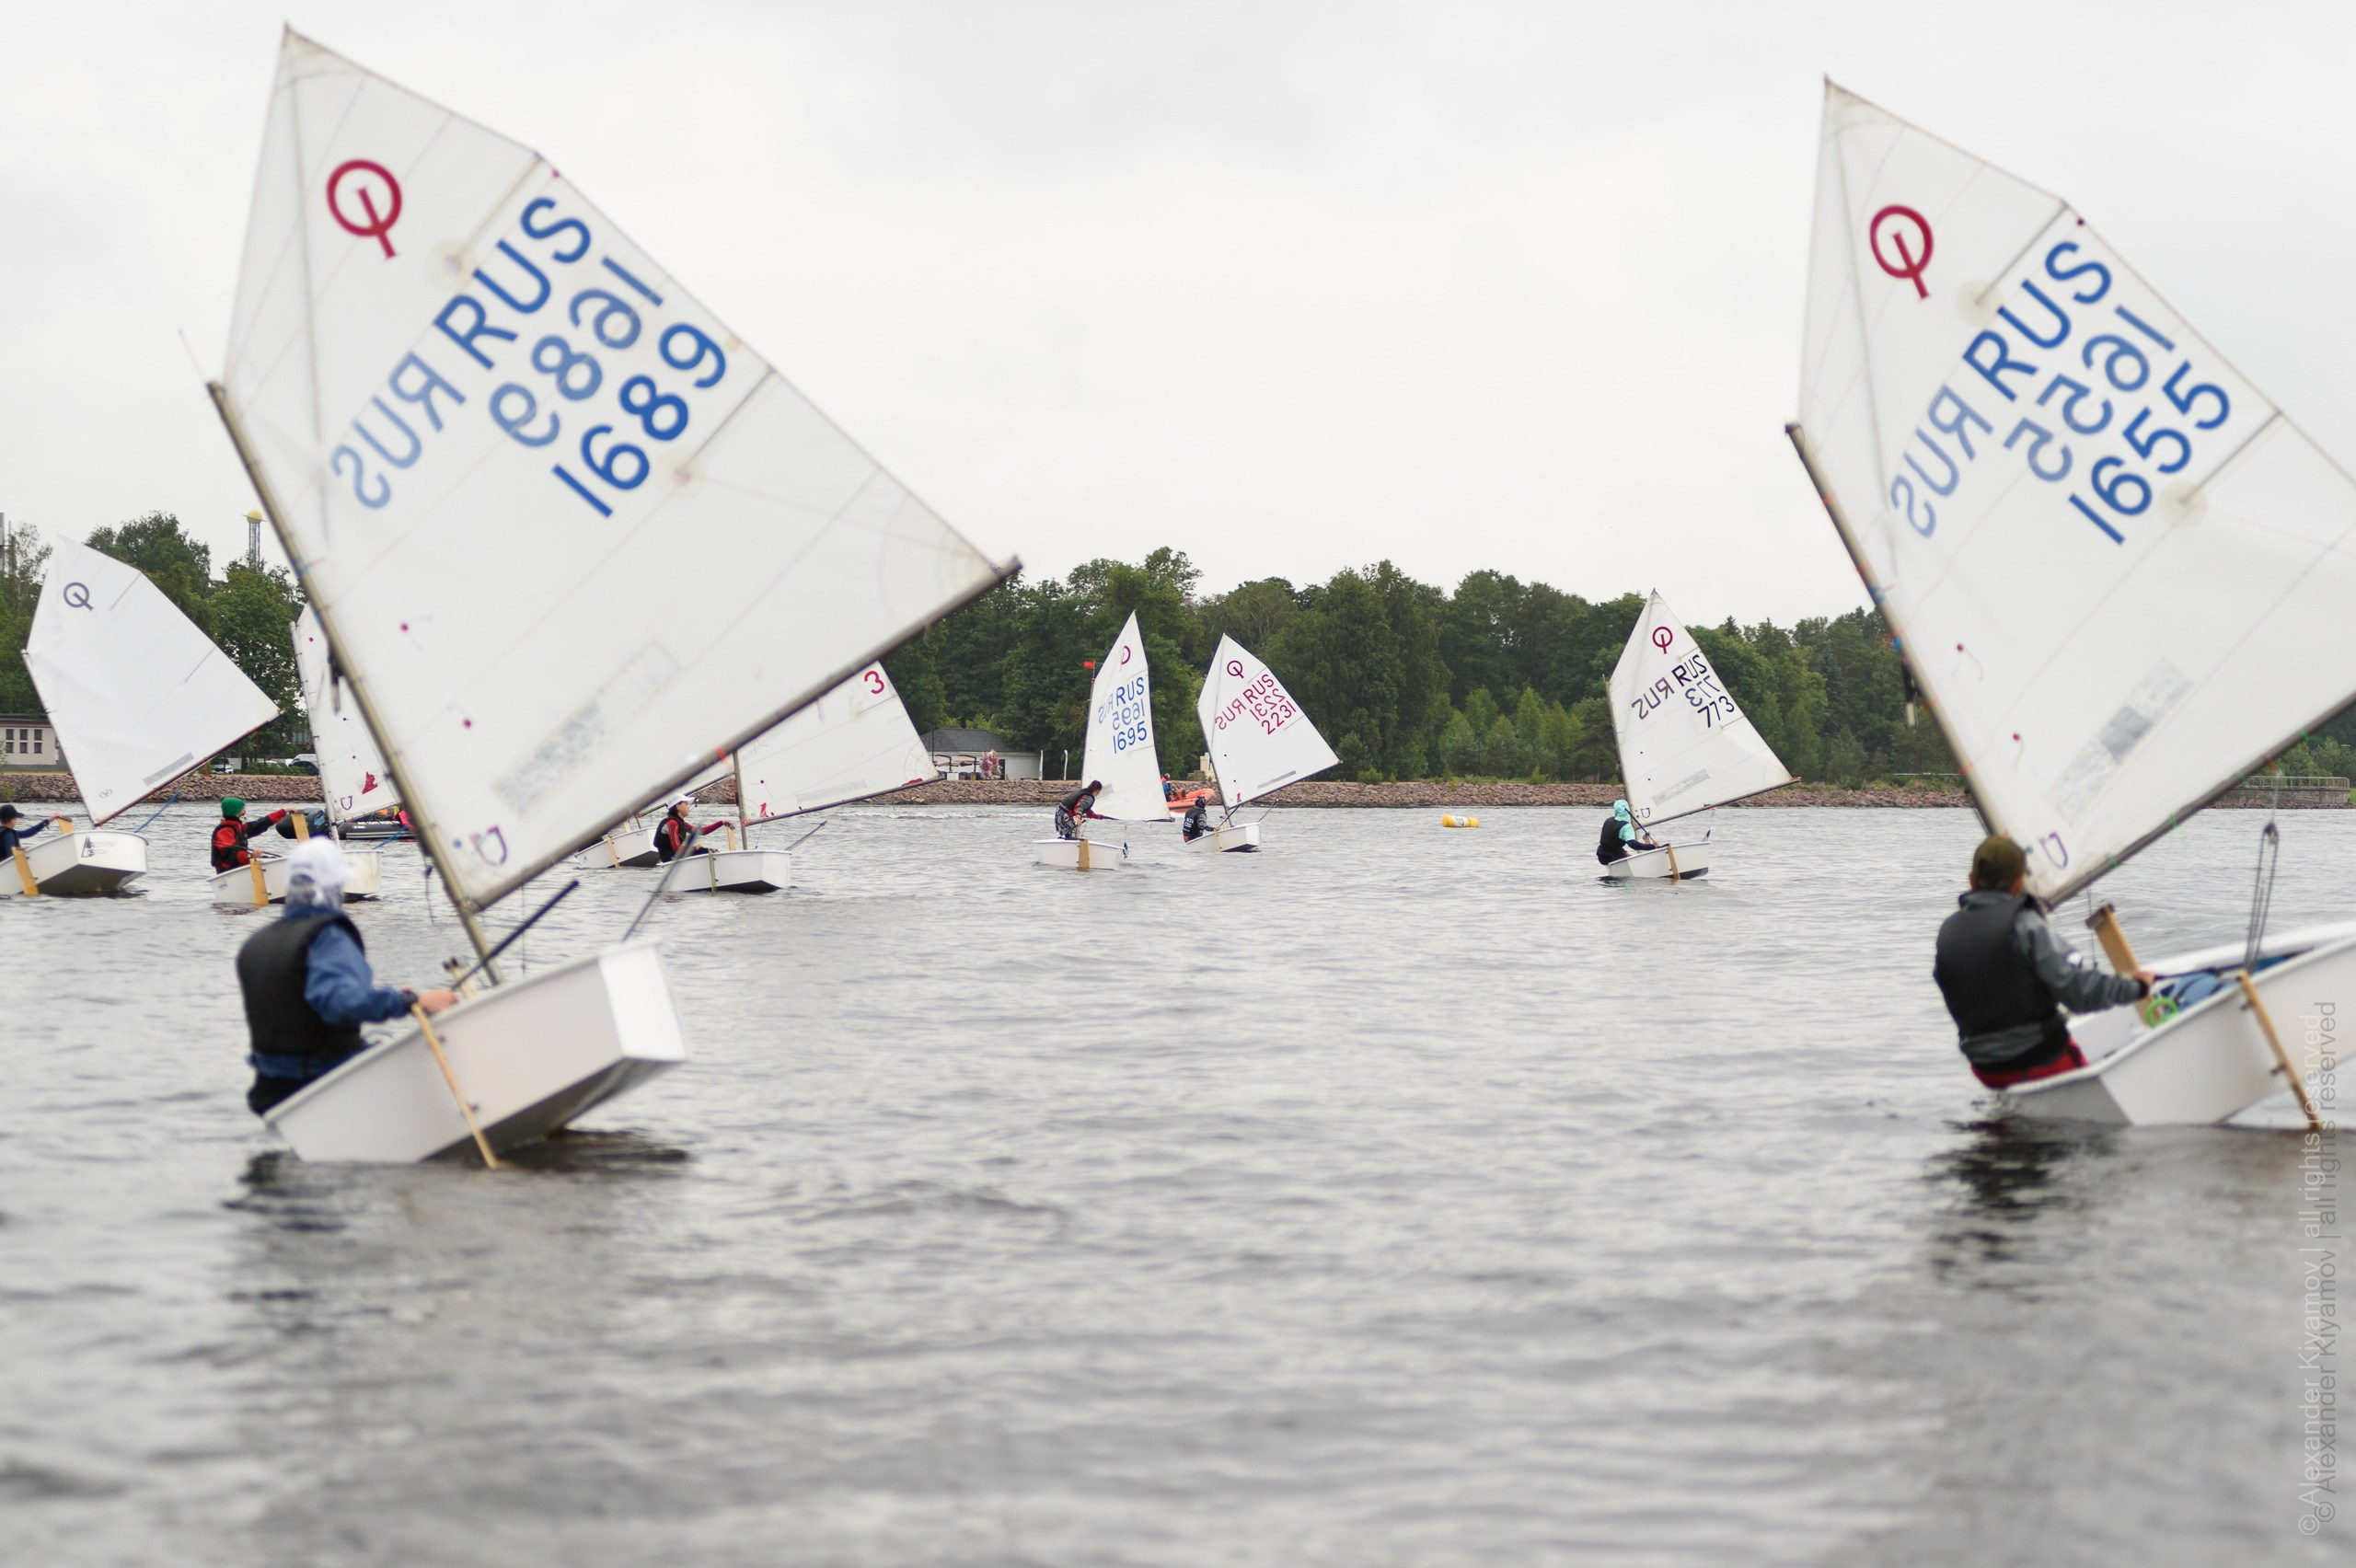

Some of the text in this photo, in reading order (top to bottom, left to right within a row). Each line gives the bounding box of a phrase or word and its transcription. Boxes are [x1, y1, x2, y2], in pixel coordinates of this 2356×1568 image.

[433, 196, 592, 371] RUS
[1962, 240, 2113, 403] RUS
[551, 322, 727, 518] 1689
[2068, 360, 2231, 545] 1655
[1670, 653, 1708, 687] RUS
[1115, 676, 1145, 707] RUS
[1242, 674, 1275, 705] RUS
[1261, 700, 1297, 735] 2231
[1696, 696, 1735, 728] 773
[1113, 720, 1148, 754] 1695
